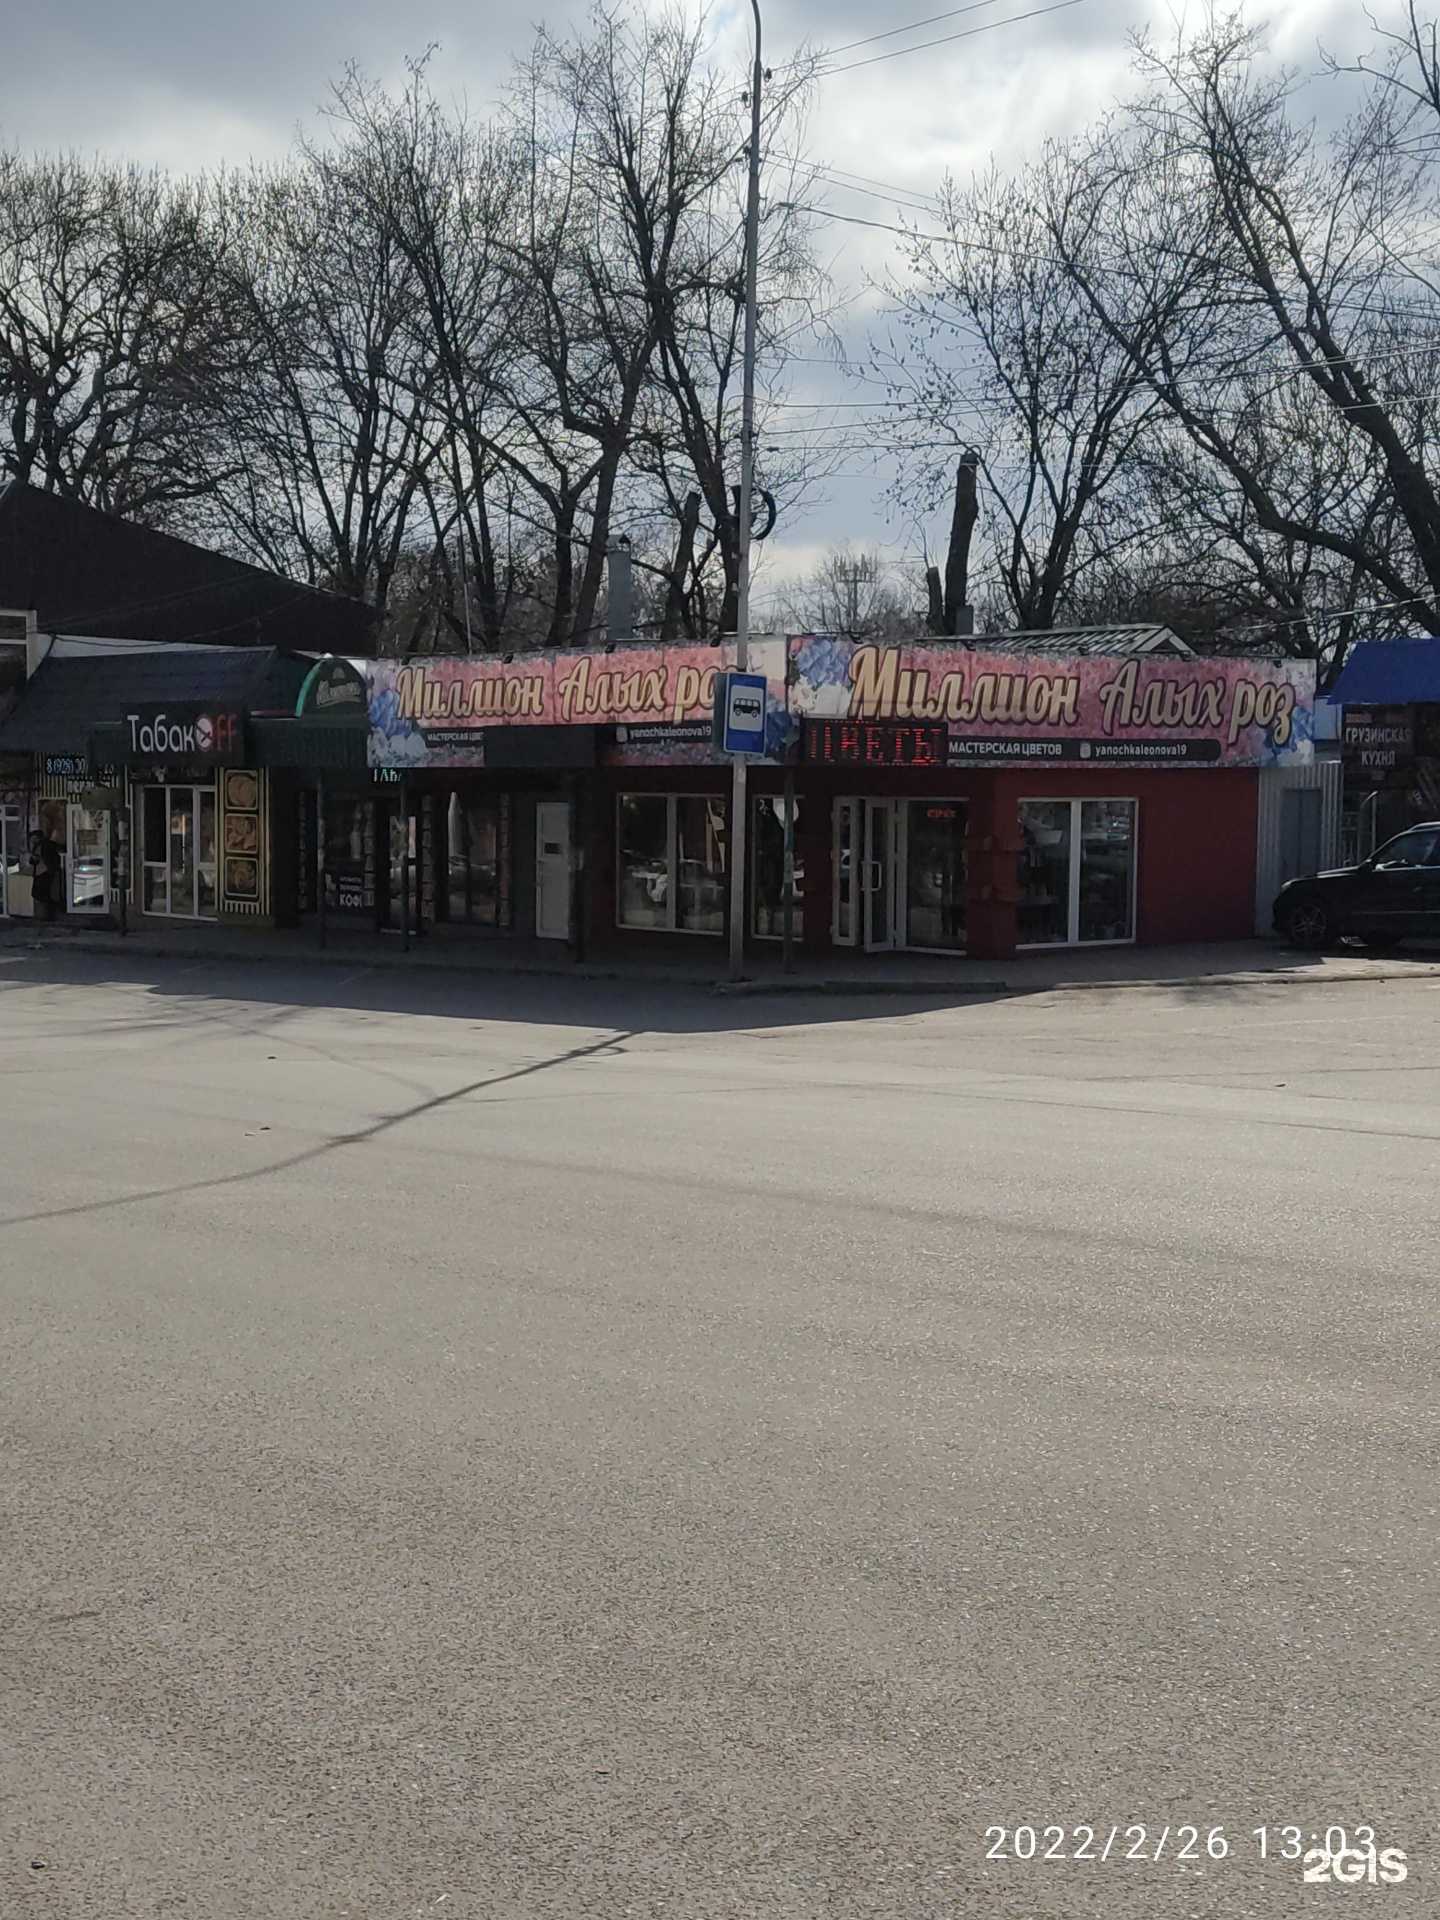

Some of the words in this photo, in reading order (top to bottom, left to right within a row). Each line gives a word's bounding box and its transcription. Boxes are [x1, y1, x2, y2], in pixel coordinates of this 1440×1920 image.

[396, 666, 545, 719] Миллион
[558, 656, 668, 722] Алых
[672, 664, 738, 726] ро
[849, 645, 1081, 726] Миллион
[1099, 658, 1226, 735] Алых
[1226, 678, 1297, 746] роз
[629, 725, 712, 741] yanochkaleonova19
[1345, 727, 1412, 744] ГРУЗИНСКАЯ
[948, 741, 1020, 754] МАСТЕРСКАЯ
[1021, 743, 1063, 757] ЦВЕТОВ
[1095, 744, 1187, 757] yanochkaleonova19
[1361, 750, 1396, 767] КУХНЯ
